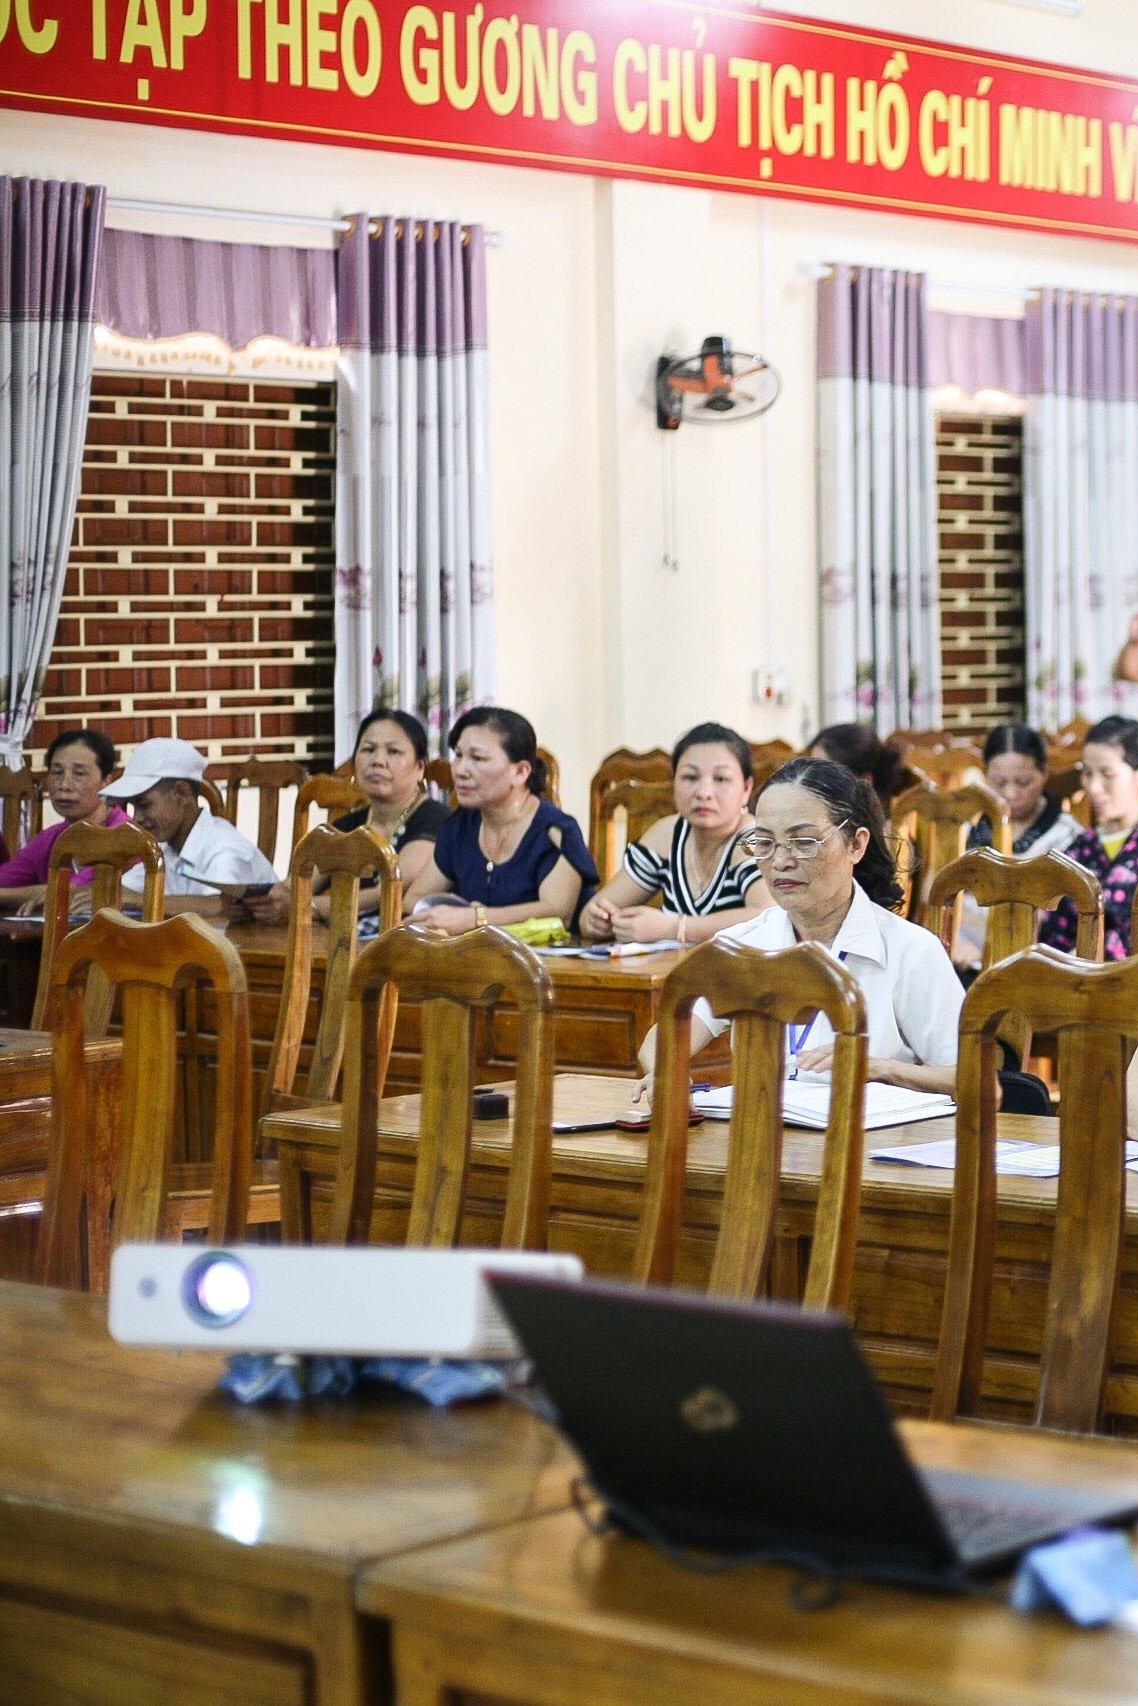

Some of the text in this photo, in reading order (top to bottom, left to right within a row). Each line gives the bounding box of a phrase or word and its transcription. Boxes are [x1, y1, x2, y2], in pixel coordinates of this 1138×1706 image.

[230, 0, 382, 98] THEO
[400, 3, 598, 126] GƯƠNG
[613, 14, 718, 144] CHỦ
[728, 57, 835, 180] TỊCH
[846, 50, 911, 172] HỒ
[919, 76, 994, 183] CHÍ
[999, 102, 1102, 199] MINH
